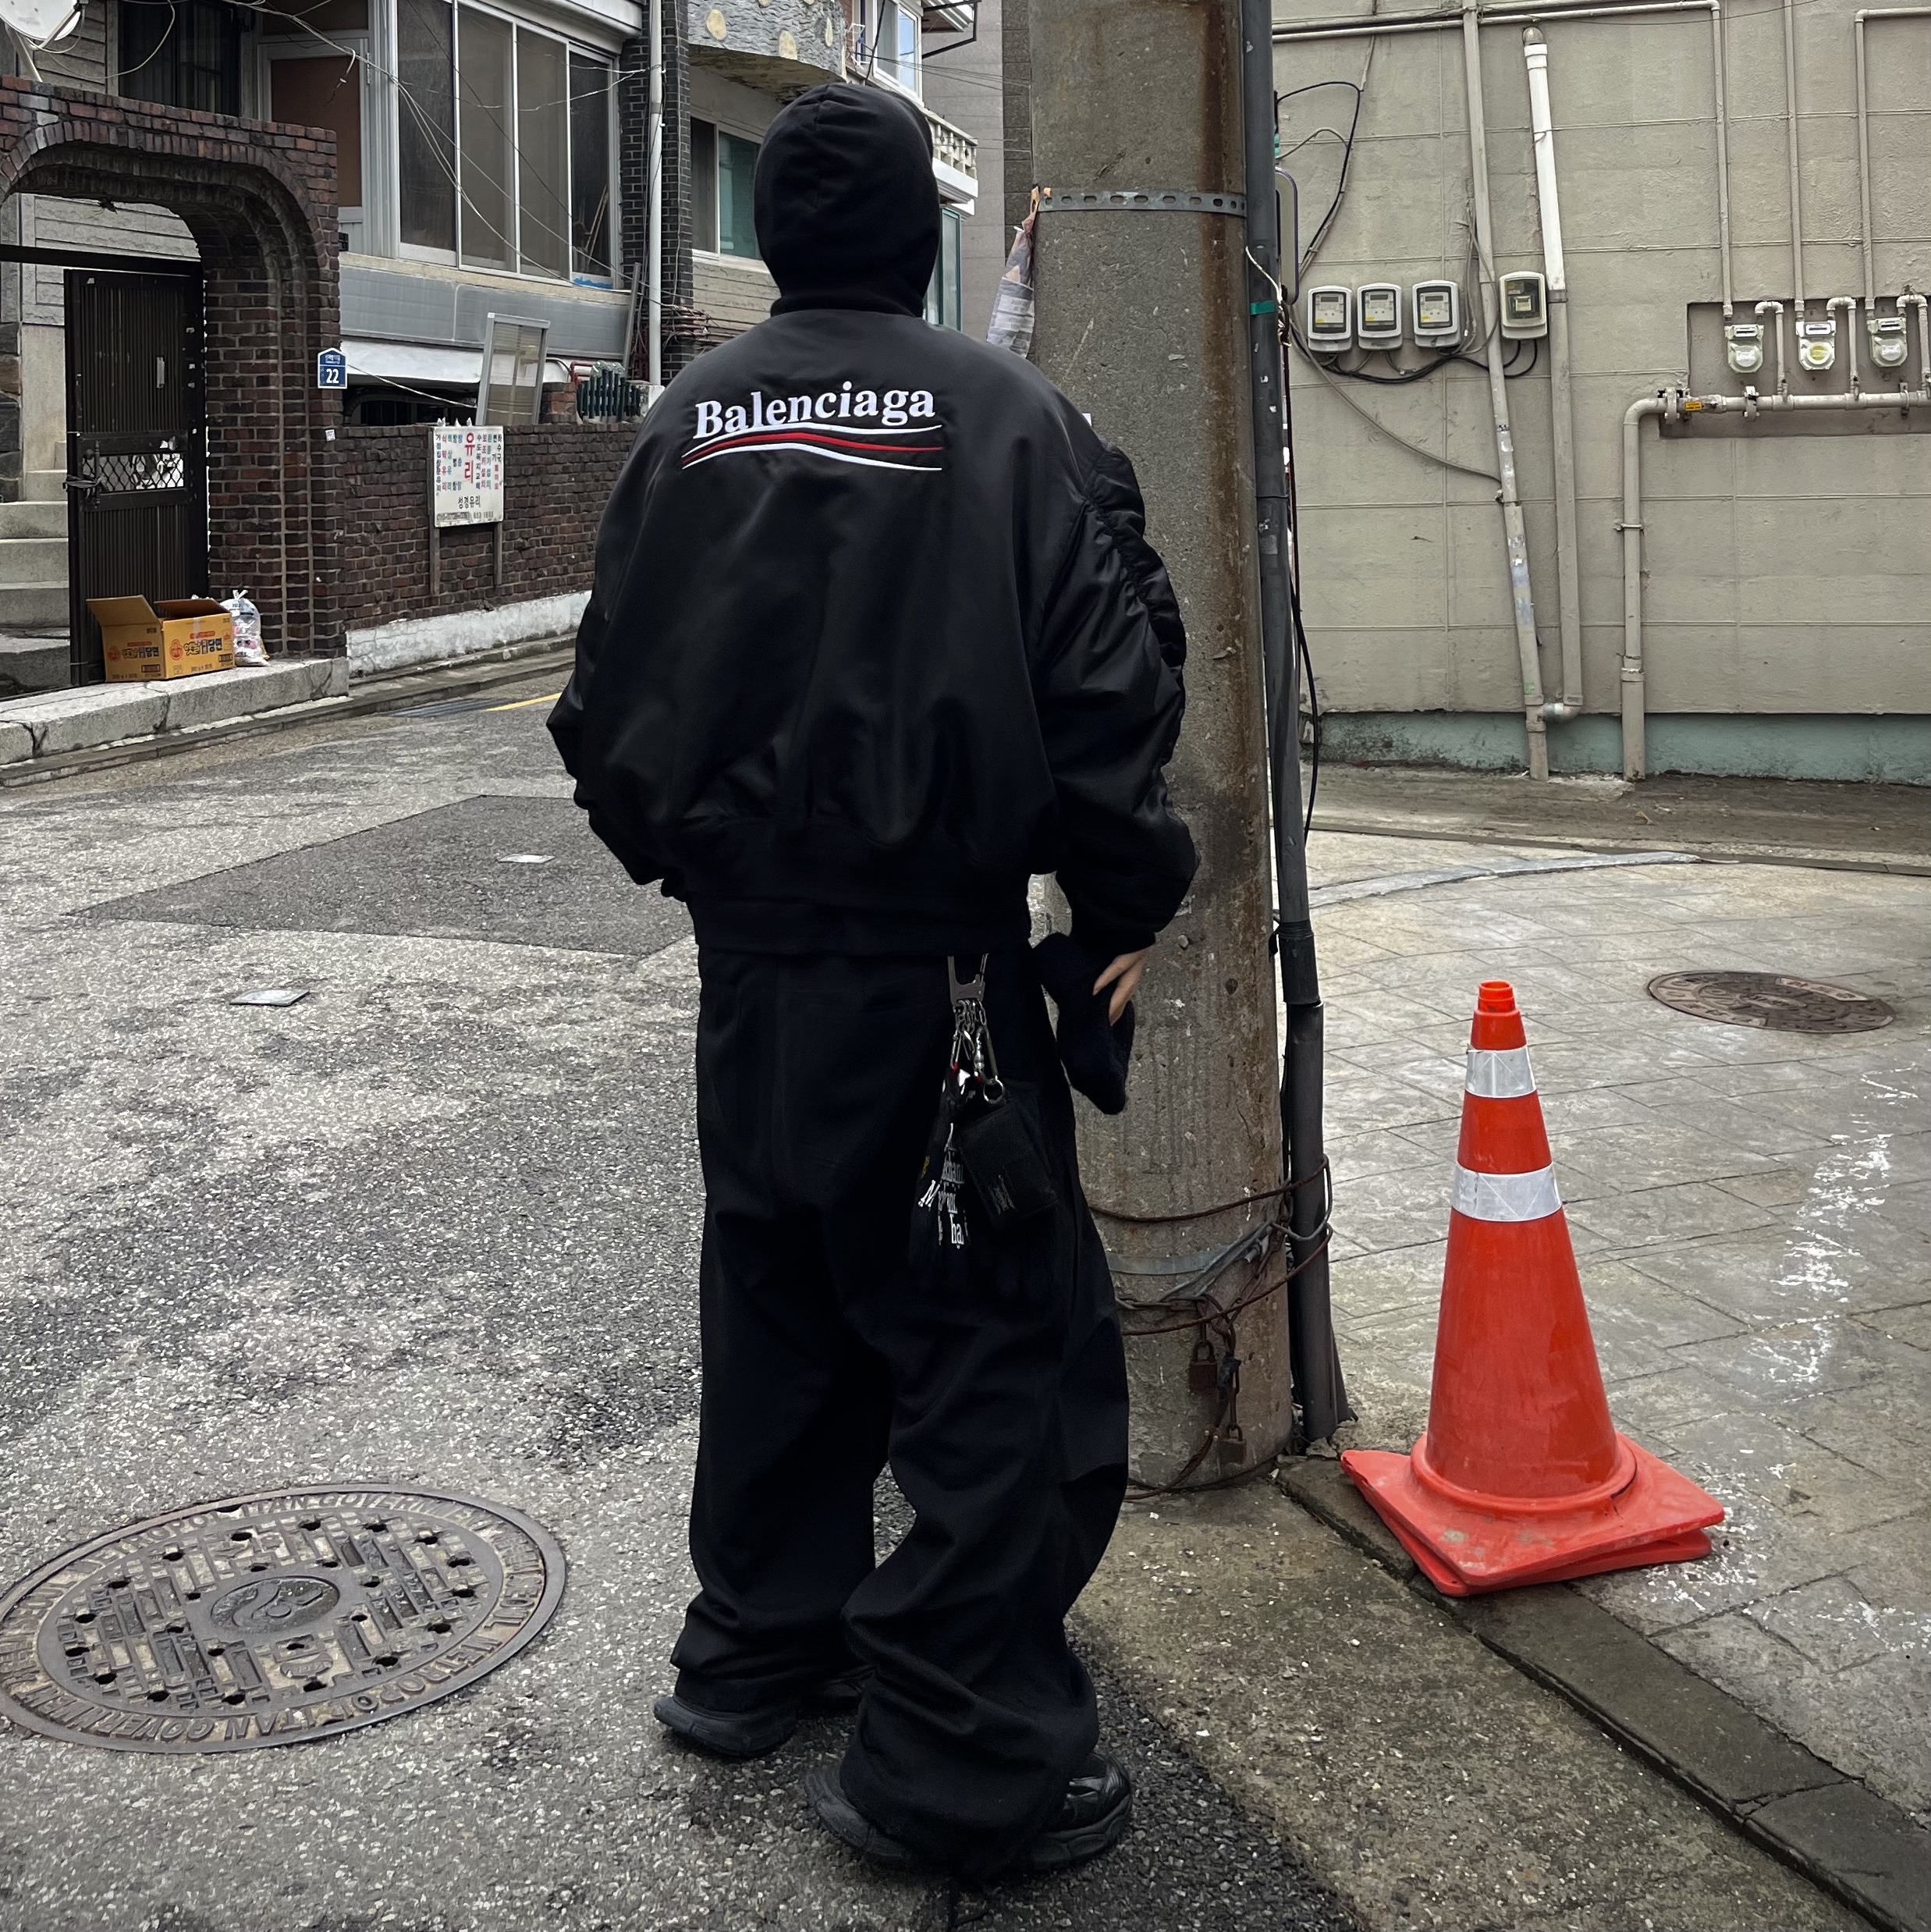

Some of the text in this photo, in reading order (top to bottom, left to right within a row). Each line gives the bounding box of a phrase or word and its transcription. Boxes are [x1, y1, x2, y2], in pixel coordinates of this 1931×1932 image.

[326, 368, 339, 384] 22
[693, 381, 936, 439] Balenciaga
[464, 432, 476, 484] 유리
[481, 1573, 542, 1634] SEOUL
